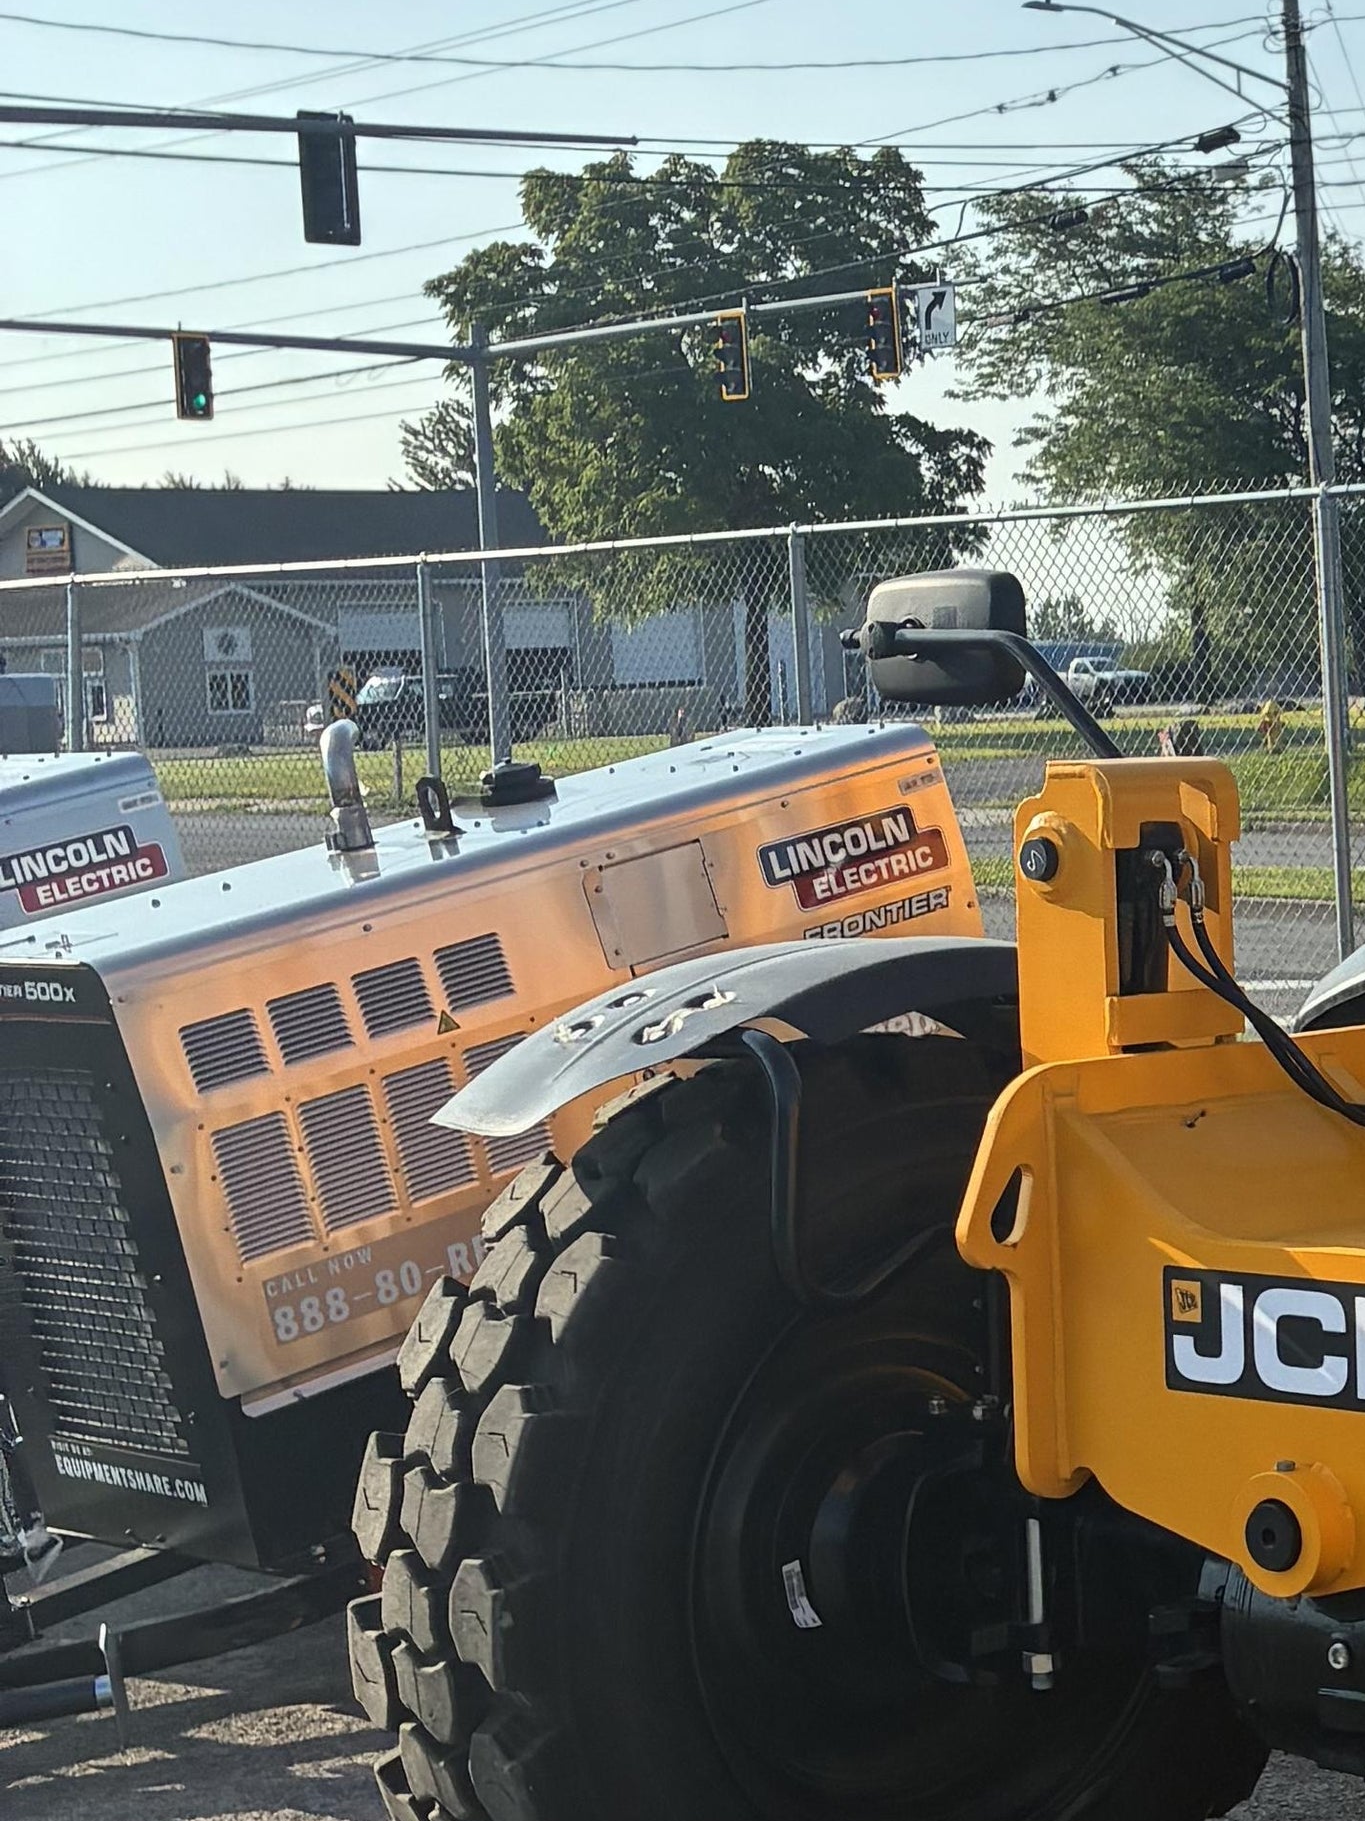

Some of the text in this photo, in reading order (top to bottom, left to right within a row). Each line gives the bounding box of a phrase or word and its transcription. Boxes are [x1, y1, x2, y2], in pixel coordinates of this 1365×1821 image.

[925, 331, 949, 345] ONLY
[768, 813, 911, 880] LINCOLN
[36, 857, 154, 906] ELECTRIC
[813, 845, 934, 901] ELECTRIC
[266, 1246, 373, 1298] CALL NOW
[55, 1453, 208, 1503] EQUIPMENTSHARE.COM
